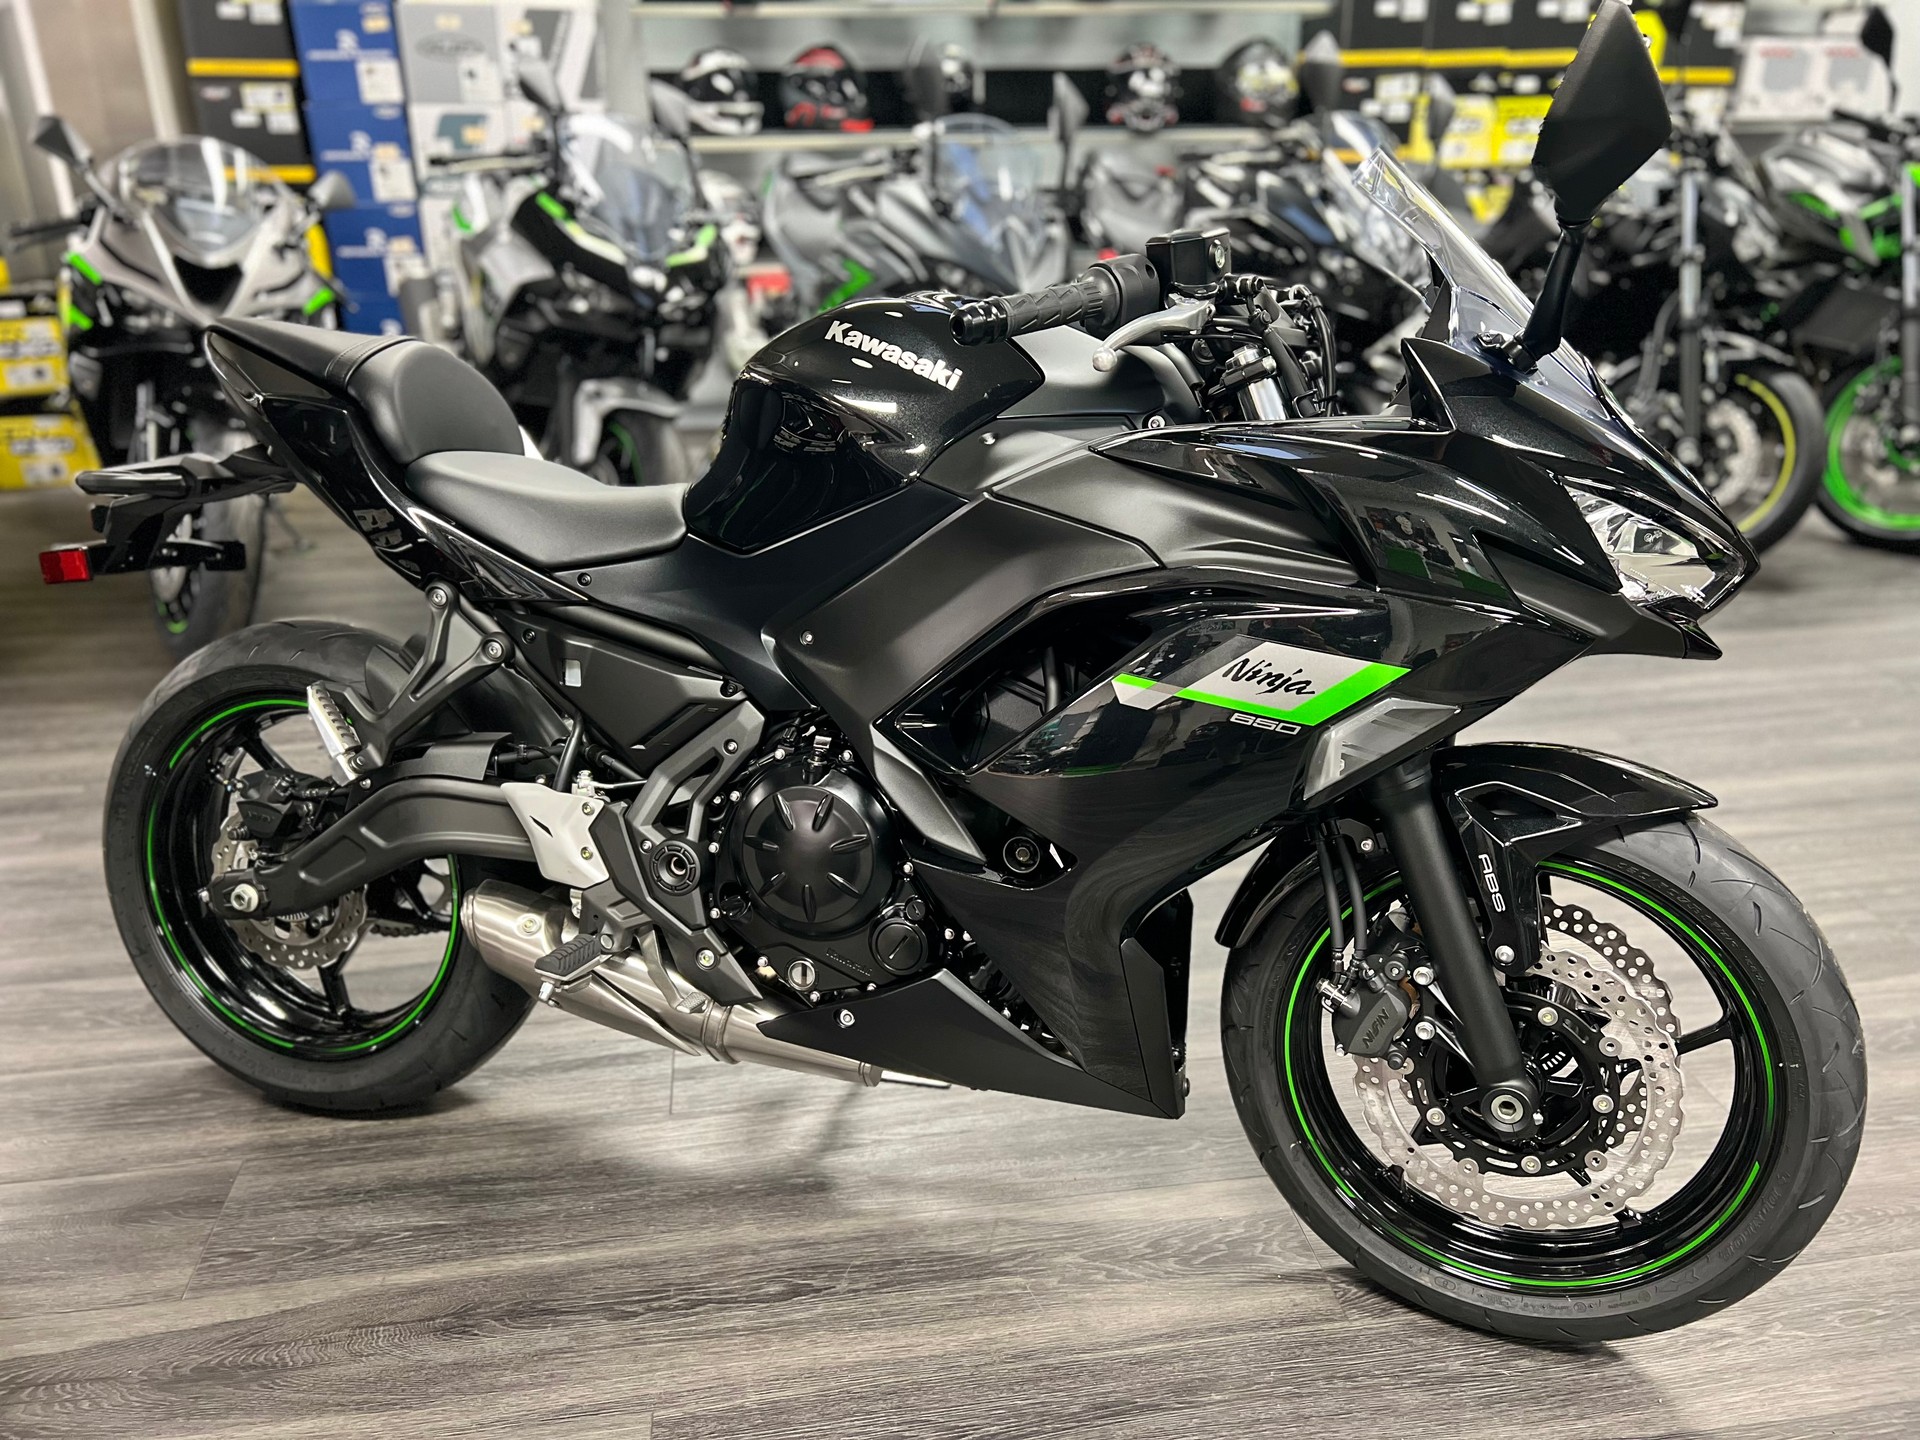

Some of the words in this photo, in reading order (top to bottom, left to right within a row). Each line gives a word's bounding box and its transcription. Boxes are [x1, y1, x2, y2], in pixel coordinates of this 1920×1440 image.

[825, 320, 963, 391] Kawasaki
[1222, 658, 1315, 695] Ninja
[1230, 713, 1301, 735] 650
[1478, 853, 1506, 912] ABS
